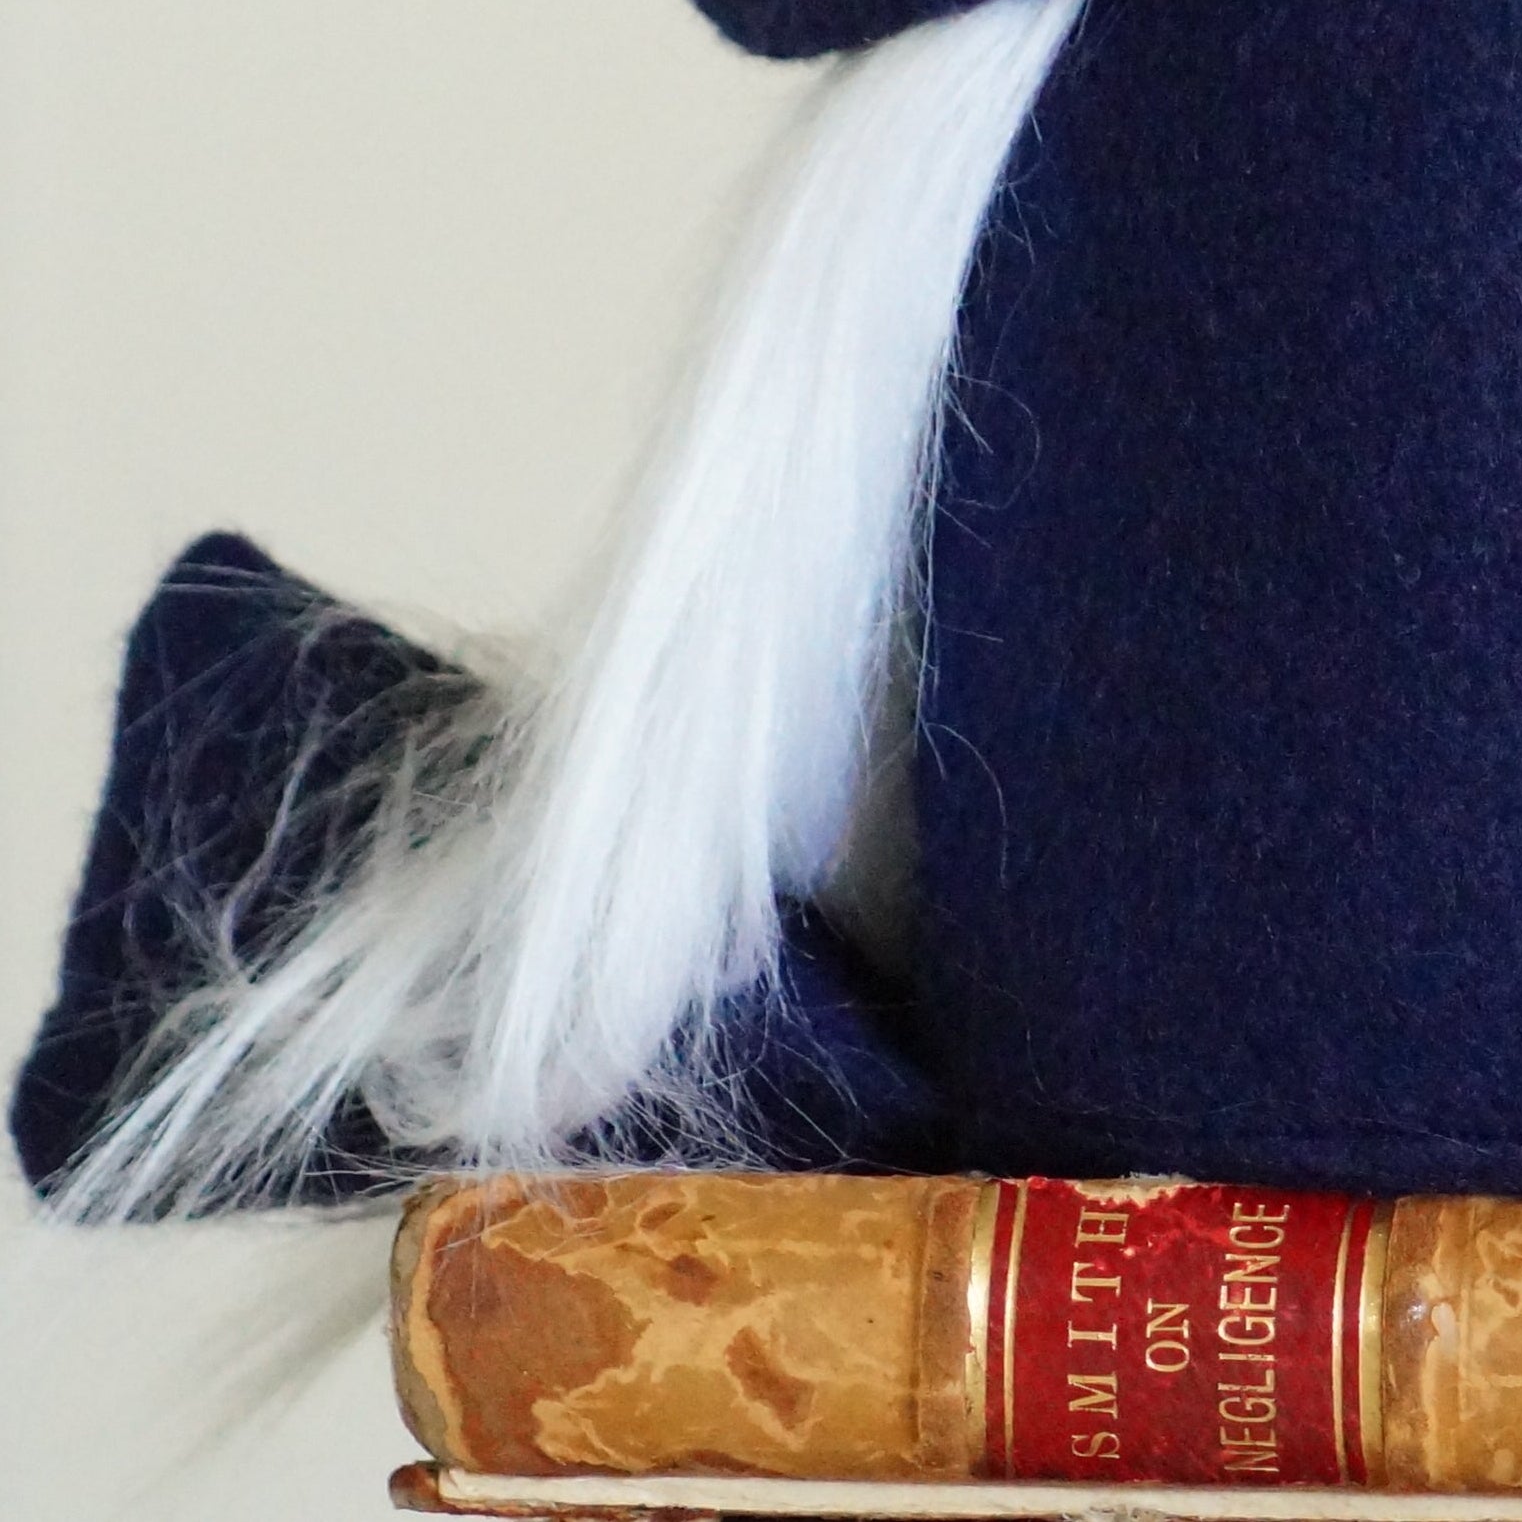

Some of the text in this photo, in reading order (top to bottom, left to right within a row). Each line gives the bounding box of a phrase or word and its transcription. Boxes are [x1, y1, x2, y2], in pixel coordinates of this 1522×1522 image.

[1067, 1205, 1131, 1460] SMITH
[1145, 1298, 1190, 1373] ON
[1217, 1201, 1291, 1473] NEGLIGENCE
